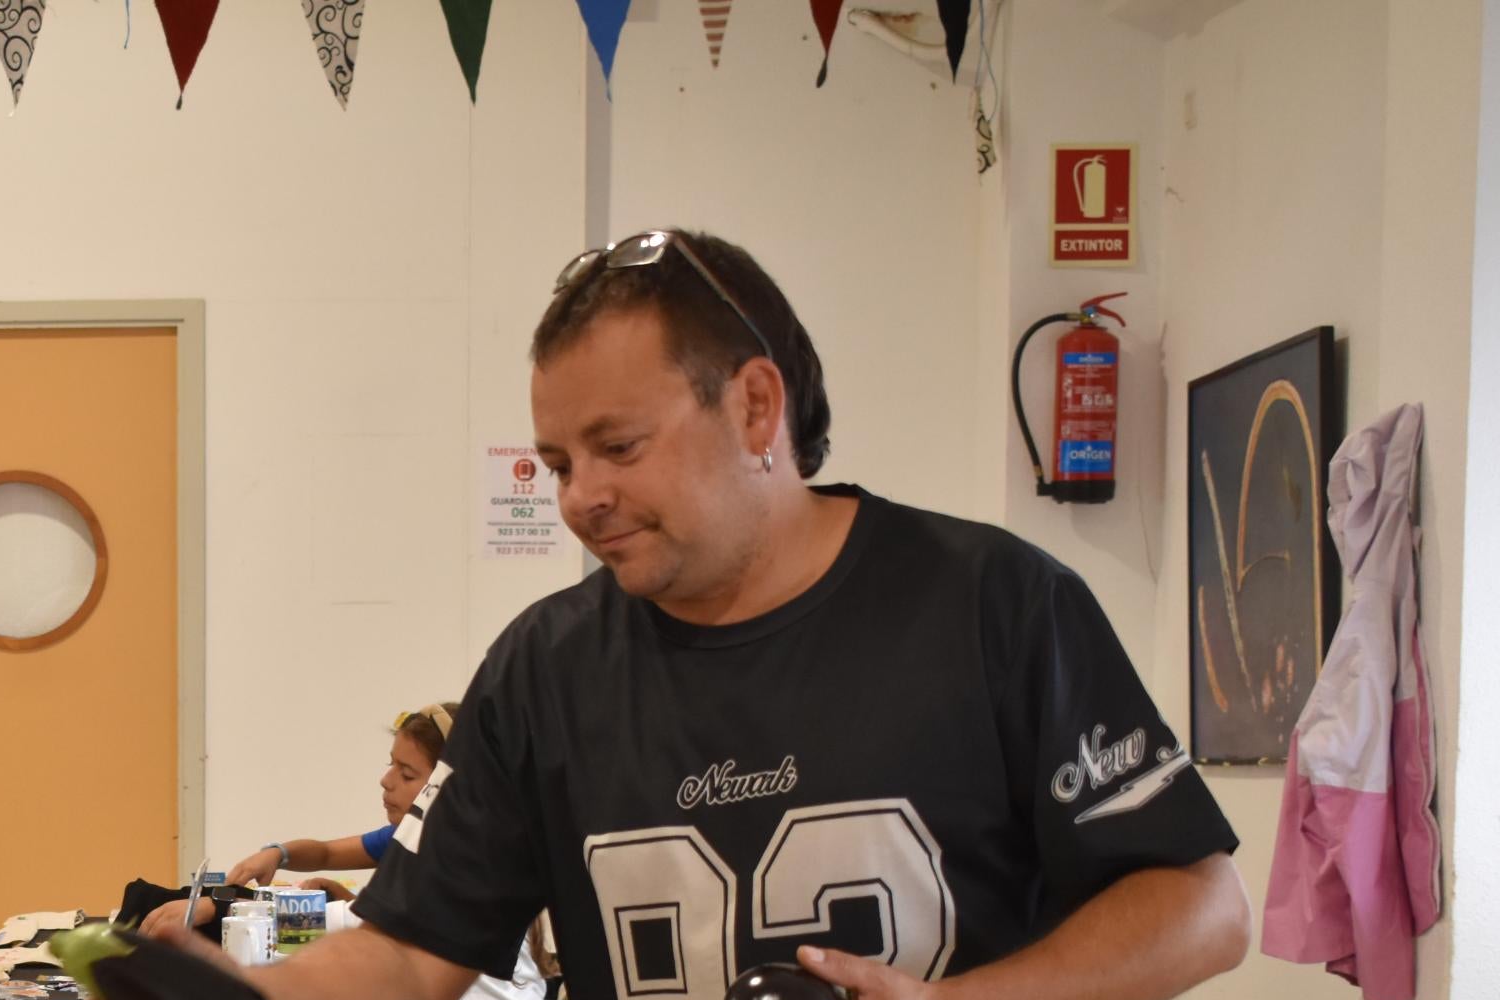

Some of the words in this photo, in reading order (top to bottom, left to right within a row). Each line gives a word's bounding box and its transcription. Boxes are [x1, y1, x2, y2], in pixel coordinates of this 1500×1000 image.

[1059, 238, 1124, 252] EXTINTOR
[487, 447, 539, 457] EMERGEN
[512, 483, 535, 495] 112
[490, 497, 530, 506] GUARDIA
[511, 506, 535, 519] 062
[1050, 724, 1146, 802] New
[677, 755, 798, 810] Newark
[277, 898, 311, 914] ADO
